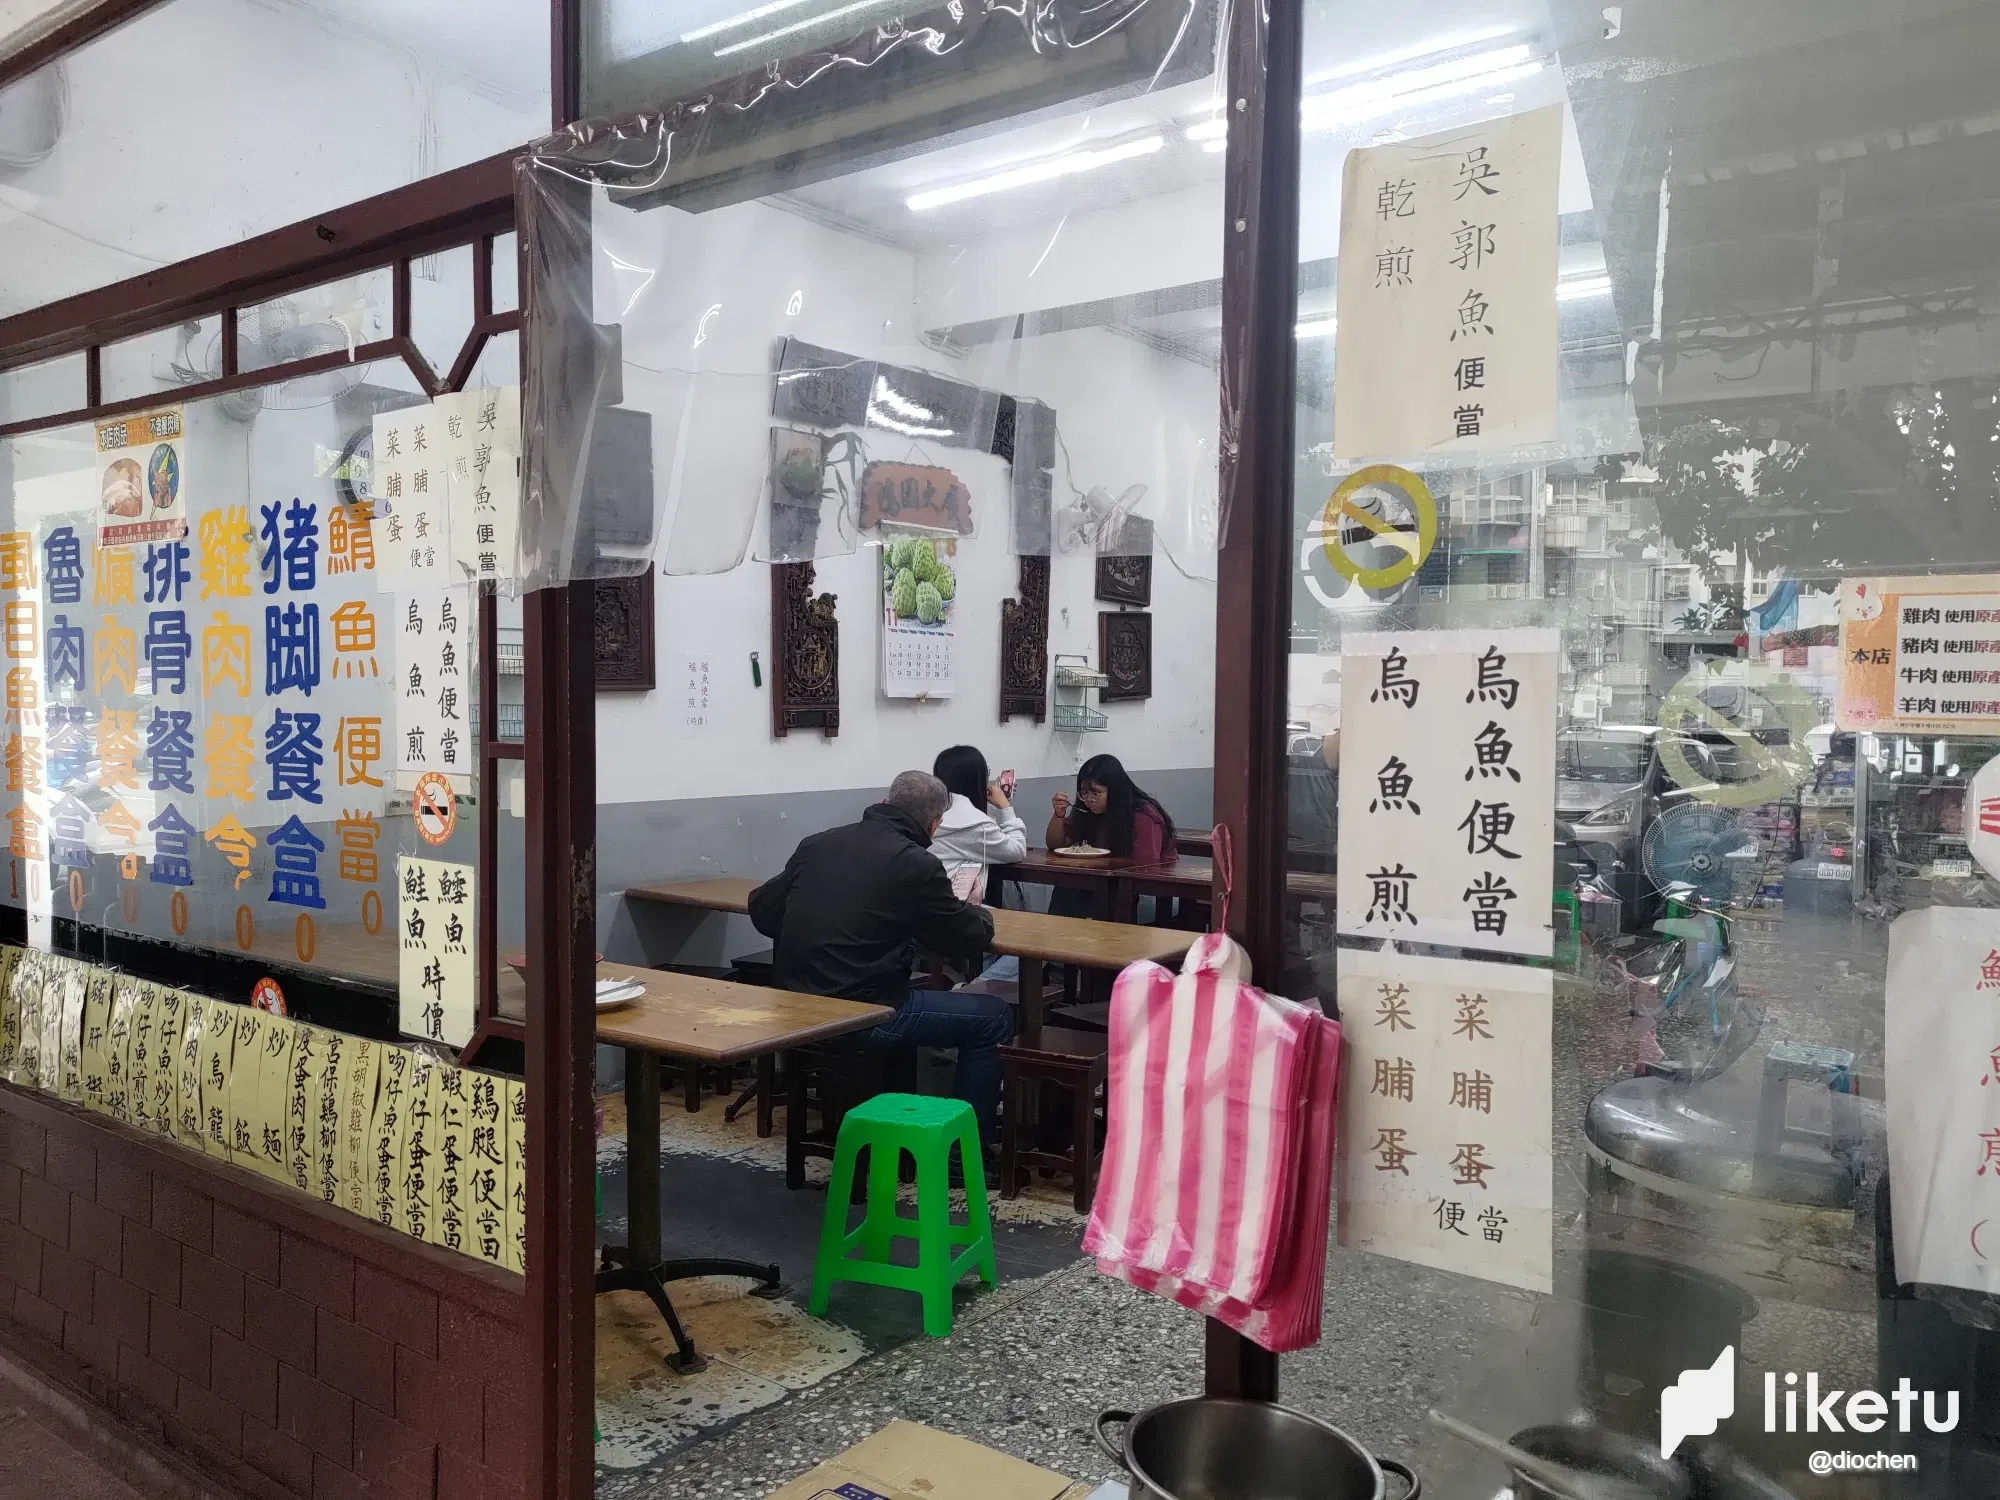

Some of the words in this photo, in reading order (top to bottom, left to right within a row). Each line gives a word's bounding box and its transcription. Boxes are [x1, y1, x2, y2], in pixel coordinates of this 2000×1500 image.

[1375, 178, 1416, 289] 乾煎
[1449, 146, 1500, 438] 吳郭魚便當
[99, 423, 128, 450] 本店肉品
[386, 428, 404, 543] 菜脯蛋
[413, 424, 430, 538] 菜脯蛋
[472, 402, 497, 571] 吳郭魚便當
[385, 501, 392, 513] 6
[410, 546, 436, 568] 便當
[886, 607, 898, 627] 11
[1851, 647, 1892, 665] 本店
[1901, 637, 1938, 654] 豬肉
[1943, 639, 2000, 654] 使用原產
[1902, 607, 1940, 624] 雞肉
[44, 527, 91, 868] 魯肉餐盒
[143, 525, 196, 886] 排骨餐盒
[327, 499, 384, 884] 鯖魚便當
[405, 599, 426, 762] 烏魚煎
[437, 597, 460, 764] 烏魚便當
[1898, 697, 1936, 714] 羊肉
[1940, 700, 2000, 714] 使用原產
[1900, 667, 1938, 684] 牛肉
[1941, 670, 2000, 684] 使用原產
[1365, 645, 1421, 928] 烏魚煎
[1457, 644, 1523, 937] 烏魚便當
[402, 864, 430, 950] 鮭魚
[437, 869, 469, 955] 鱈魚
[421, 955, 446, 1041] 時價
[154, 990, 178, 1140] 吻仔魚炒飯
[234, 1016, 261, 1153] 炒飯
[262, 1027, 289, 1163] 炒麵
[1370, 981, 1418, 1177] 菜脯蛋
[1448, 992, 1495, 1190] 菜脯蛋
[436, 1069, 467, 1250] 蝦仁蛋便當
[1432, 1197, 1509, 1245] 便當
